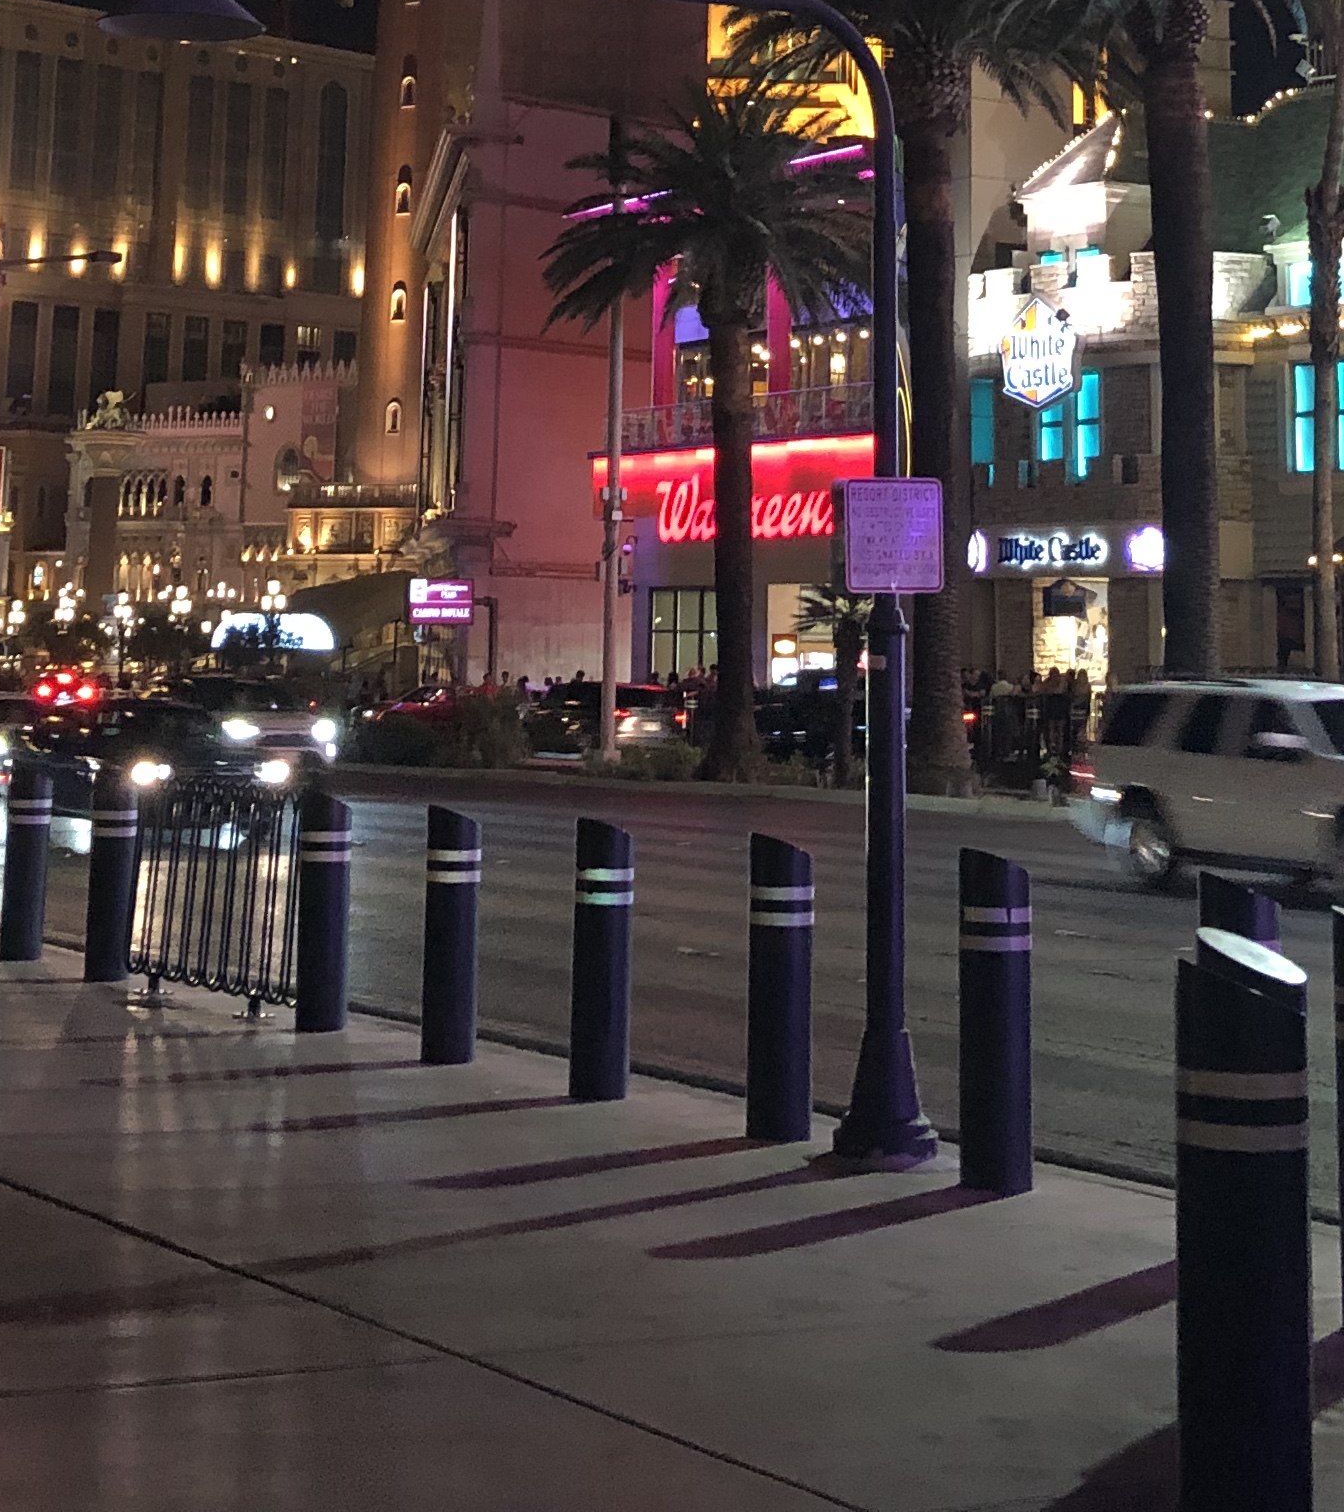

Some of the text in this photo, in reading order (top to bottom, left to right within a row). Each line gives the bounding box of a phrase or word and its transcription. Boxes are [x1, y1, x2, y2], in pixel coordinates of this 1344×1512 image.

[1011, 335, 1065, 360] White
[1007, 362, 1068, 389] Castle
[998, 536, 1102, 564] White Castle
